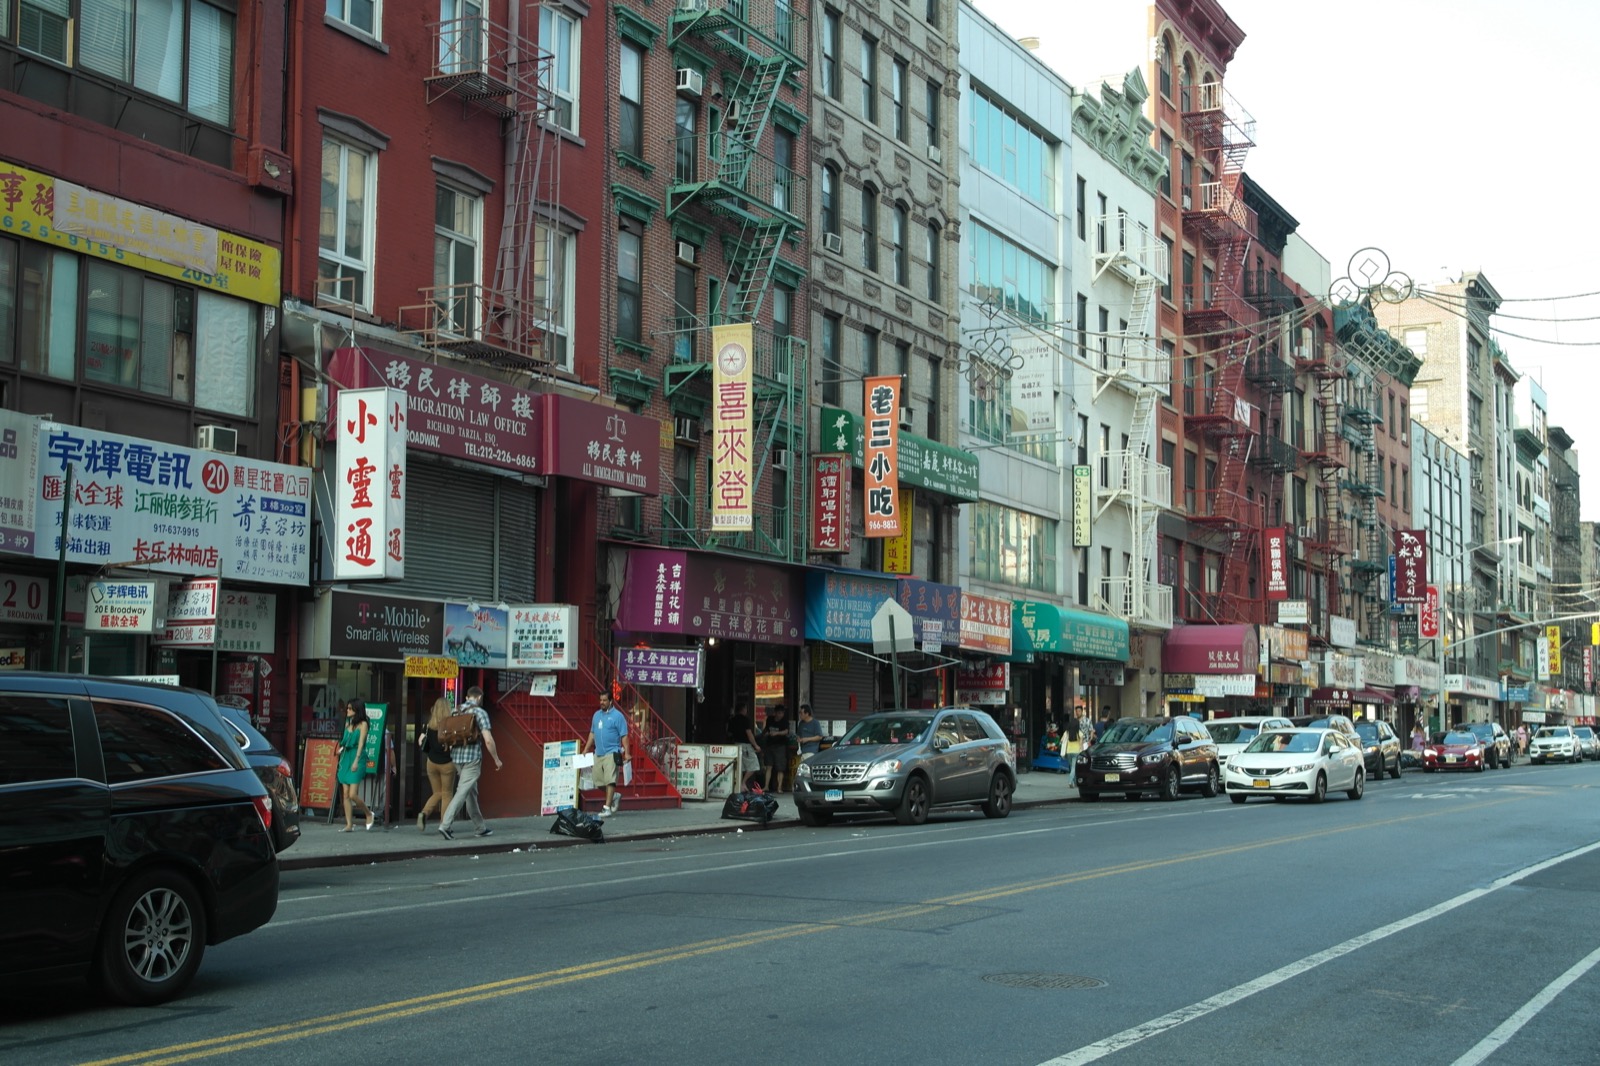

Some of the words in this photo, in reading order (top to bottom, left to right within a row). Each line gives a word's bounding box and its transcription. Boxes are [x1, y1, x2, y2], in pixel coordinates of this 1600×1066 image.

[407, 396, 465, 422] MIGRATION
[470, 409, 490, 427] LAW
[494, 416, 527, 437] OFFICE
[426, 419, 455, 436] RICHARD
[587, 440, 642, 471] 移民案件
[717, 381, 748, 509] 喜來登
[869, 385, 894, 517] 老三小吃
[48, 431, 193, 490] 宇輝電訊
[207, 463, 225, 490] 20
[233, 465, 309, 499] 藝星珠寶公司
[346, 399, 378, 567] 小靈通
[388, 401, 405, 562] 小靈通
[582, 463, 592, 476] ALL
[594, 465, 625, 483] IMMIGRATION
[626, 472, 647, 488] MATTERS
[154, 524, 199, 537] 917-637-9915
[3, 579, 41, 609] 20
[107, 585, 148, 599] 宇辉电讯
[7, 610, 43, 621] BROADWAY
[101, 615, 139, 628] 匯款全球
[110, 605, 147, 615] Broadway
[345, 626, 389, 642] SmarTalk
[391, 629, 430, 646] Wireless
[708, 628, 727, 637] LUCKY
[729, 631, 750, 640] FLORIST
[311, 721, 336, 733] LINES
